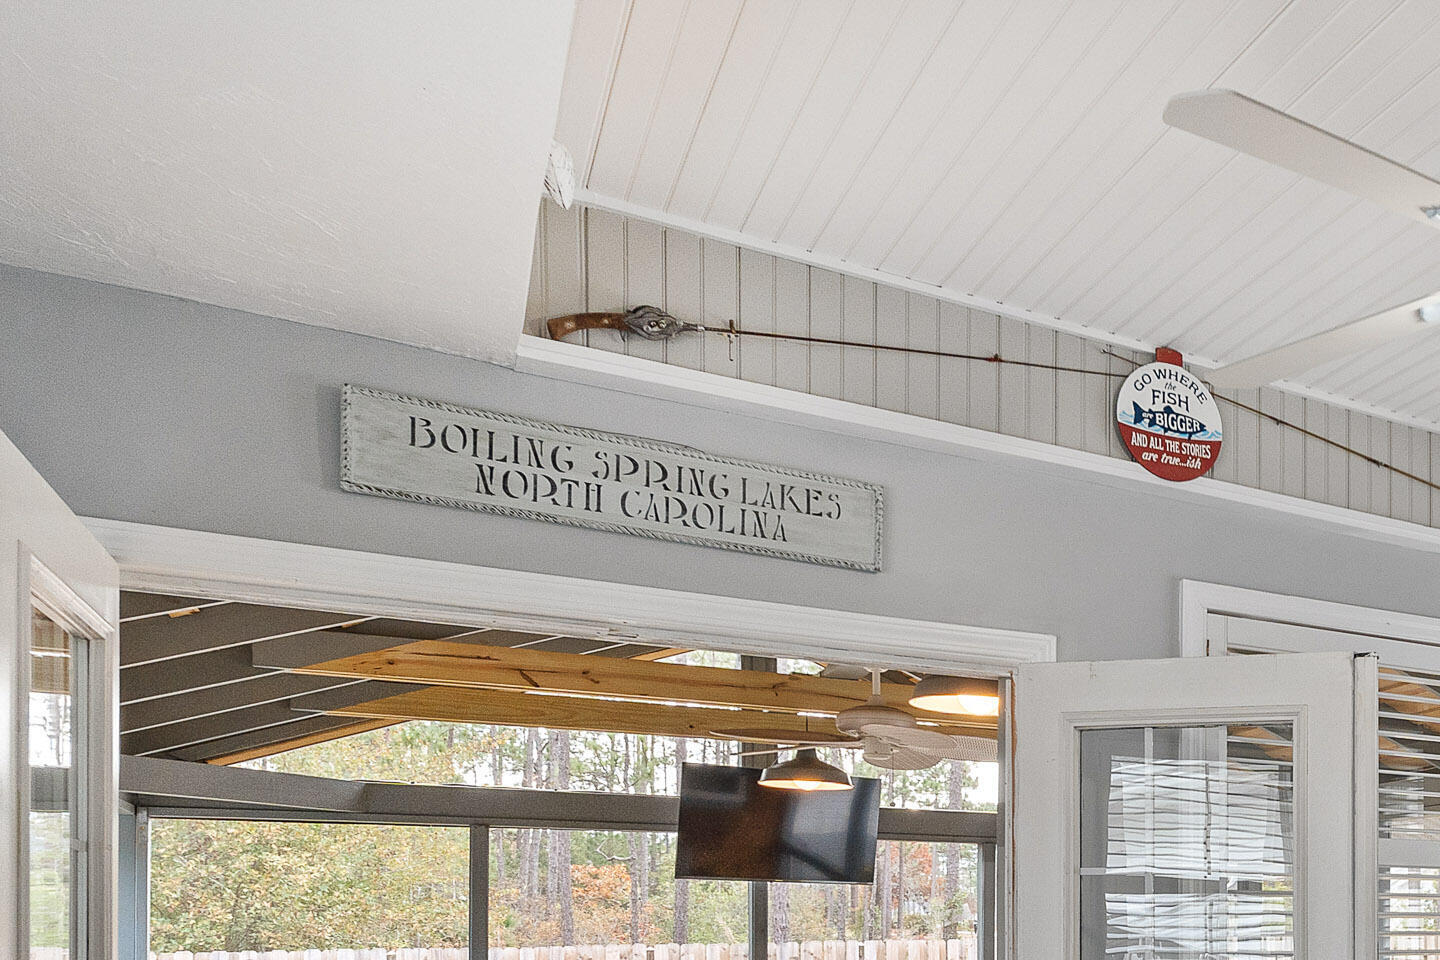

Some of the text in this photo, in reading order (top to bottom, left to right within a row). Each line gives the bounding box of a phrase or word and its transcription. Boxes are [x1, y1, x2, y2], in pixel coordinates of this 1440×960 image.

[1133, 368, 1207, 404] GO WHERE
[1164, 381, 1177, 391] the
[1152, 388, 1189, 413] FISH
[1155, 412, 1201, 432] BIGGER
[1131, 431, 1211, 459] AND ALL THE STORIES
[1141, 451, 1159, 462] are
[408, 416, 842, 521] BOILING SPRING LAKES
[474, 463, 788, 542] NORTH CAROLINA
